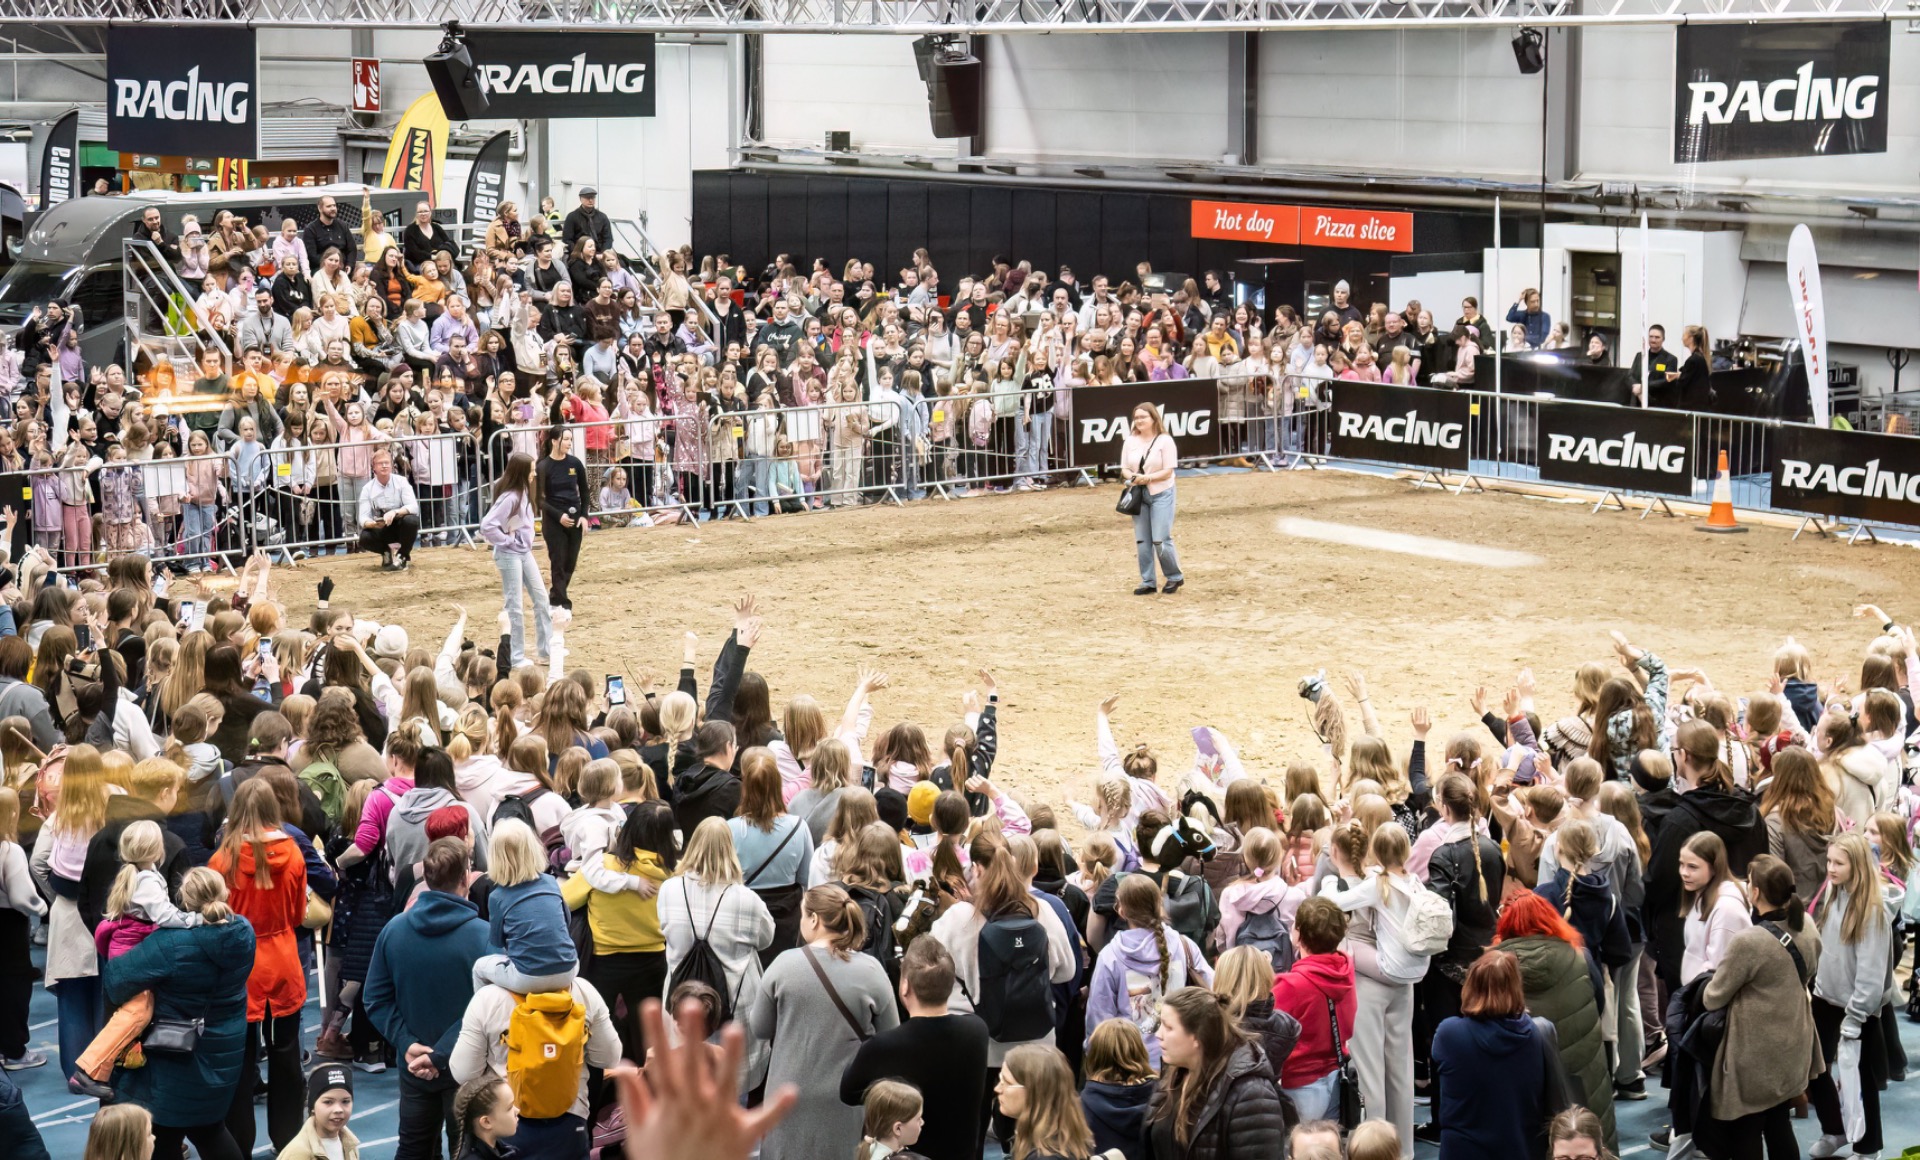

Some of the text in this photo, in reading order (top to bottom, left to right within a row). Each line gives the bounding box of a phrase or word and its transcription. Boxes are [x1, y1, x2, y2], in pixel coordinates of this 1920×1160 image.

[1213, 208, 1275, 240] Hot dog
[1314, 214, 1396, 241] Pizza slice
[1079, 403, 1211, 444] RANG
